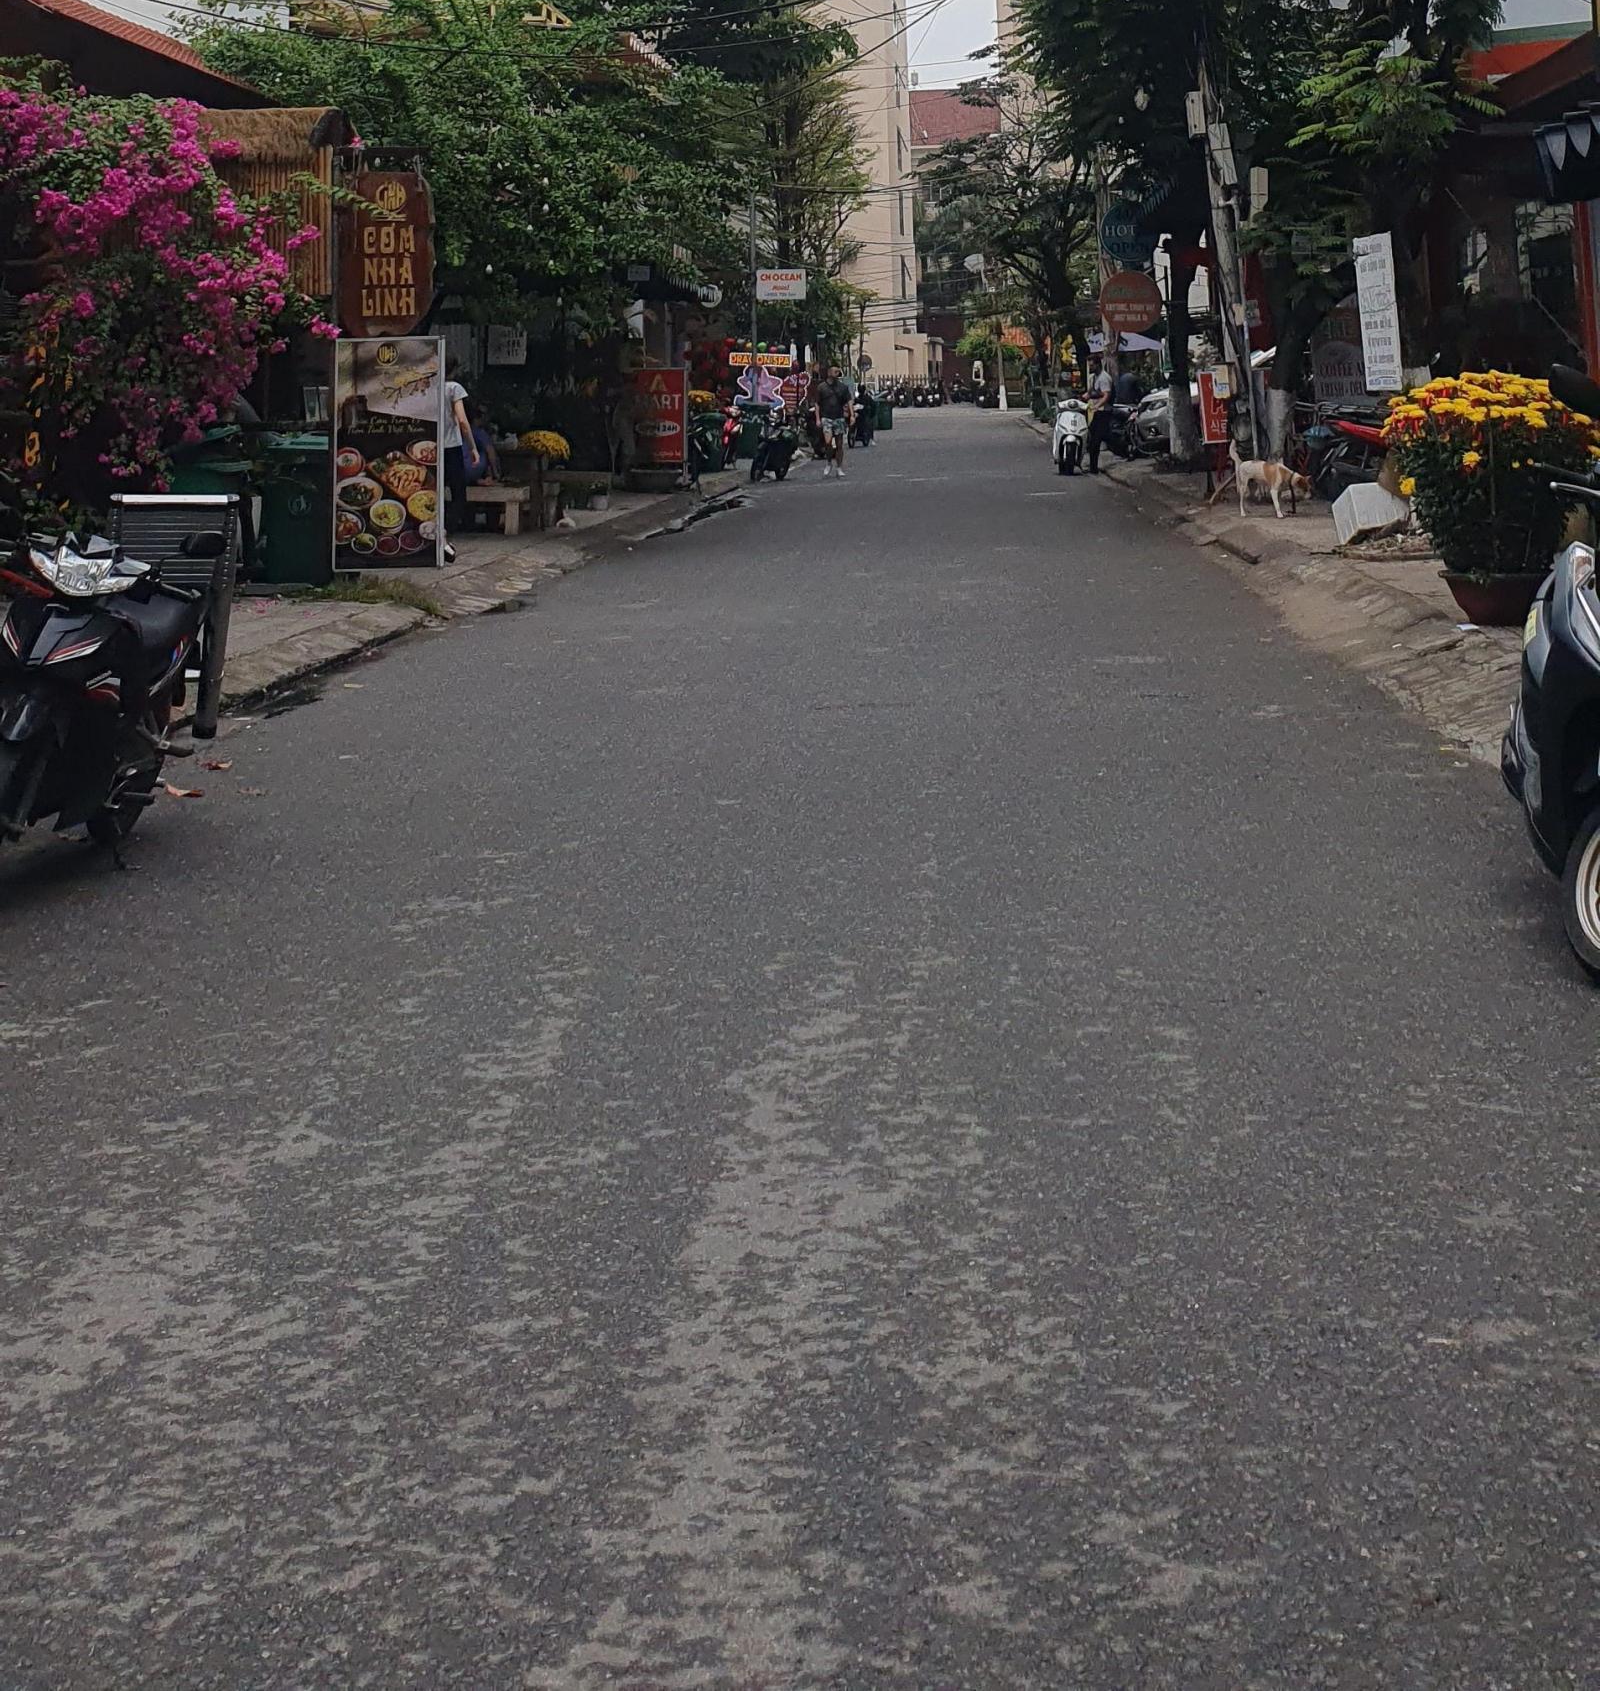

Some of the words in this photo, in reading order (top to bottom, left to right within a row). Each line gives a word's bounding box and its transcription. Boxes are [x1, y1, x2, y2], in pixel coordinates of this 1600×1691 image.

[363, 223, 416, 254] CƠM
[1105, 224, 1137, 237] HOT
[363, 252, 414, 286] NHÀ
[772, 273, 802, 281] OCEAN
[361, 288, 417, 317] LINH
[731, 354, 770, 365] DRAON
[772, 355, 790, 366] SPA
